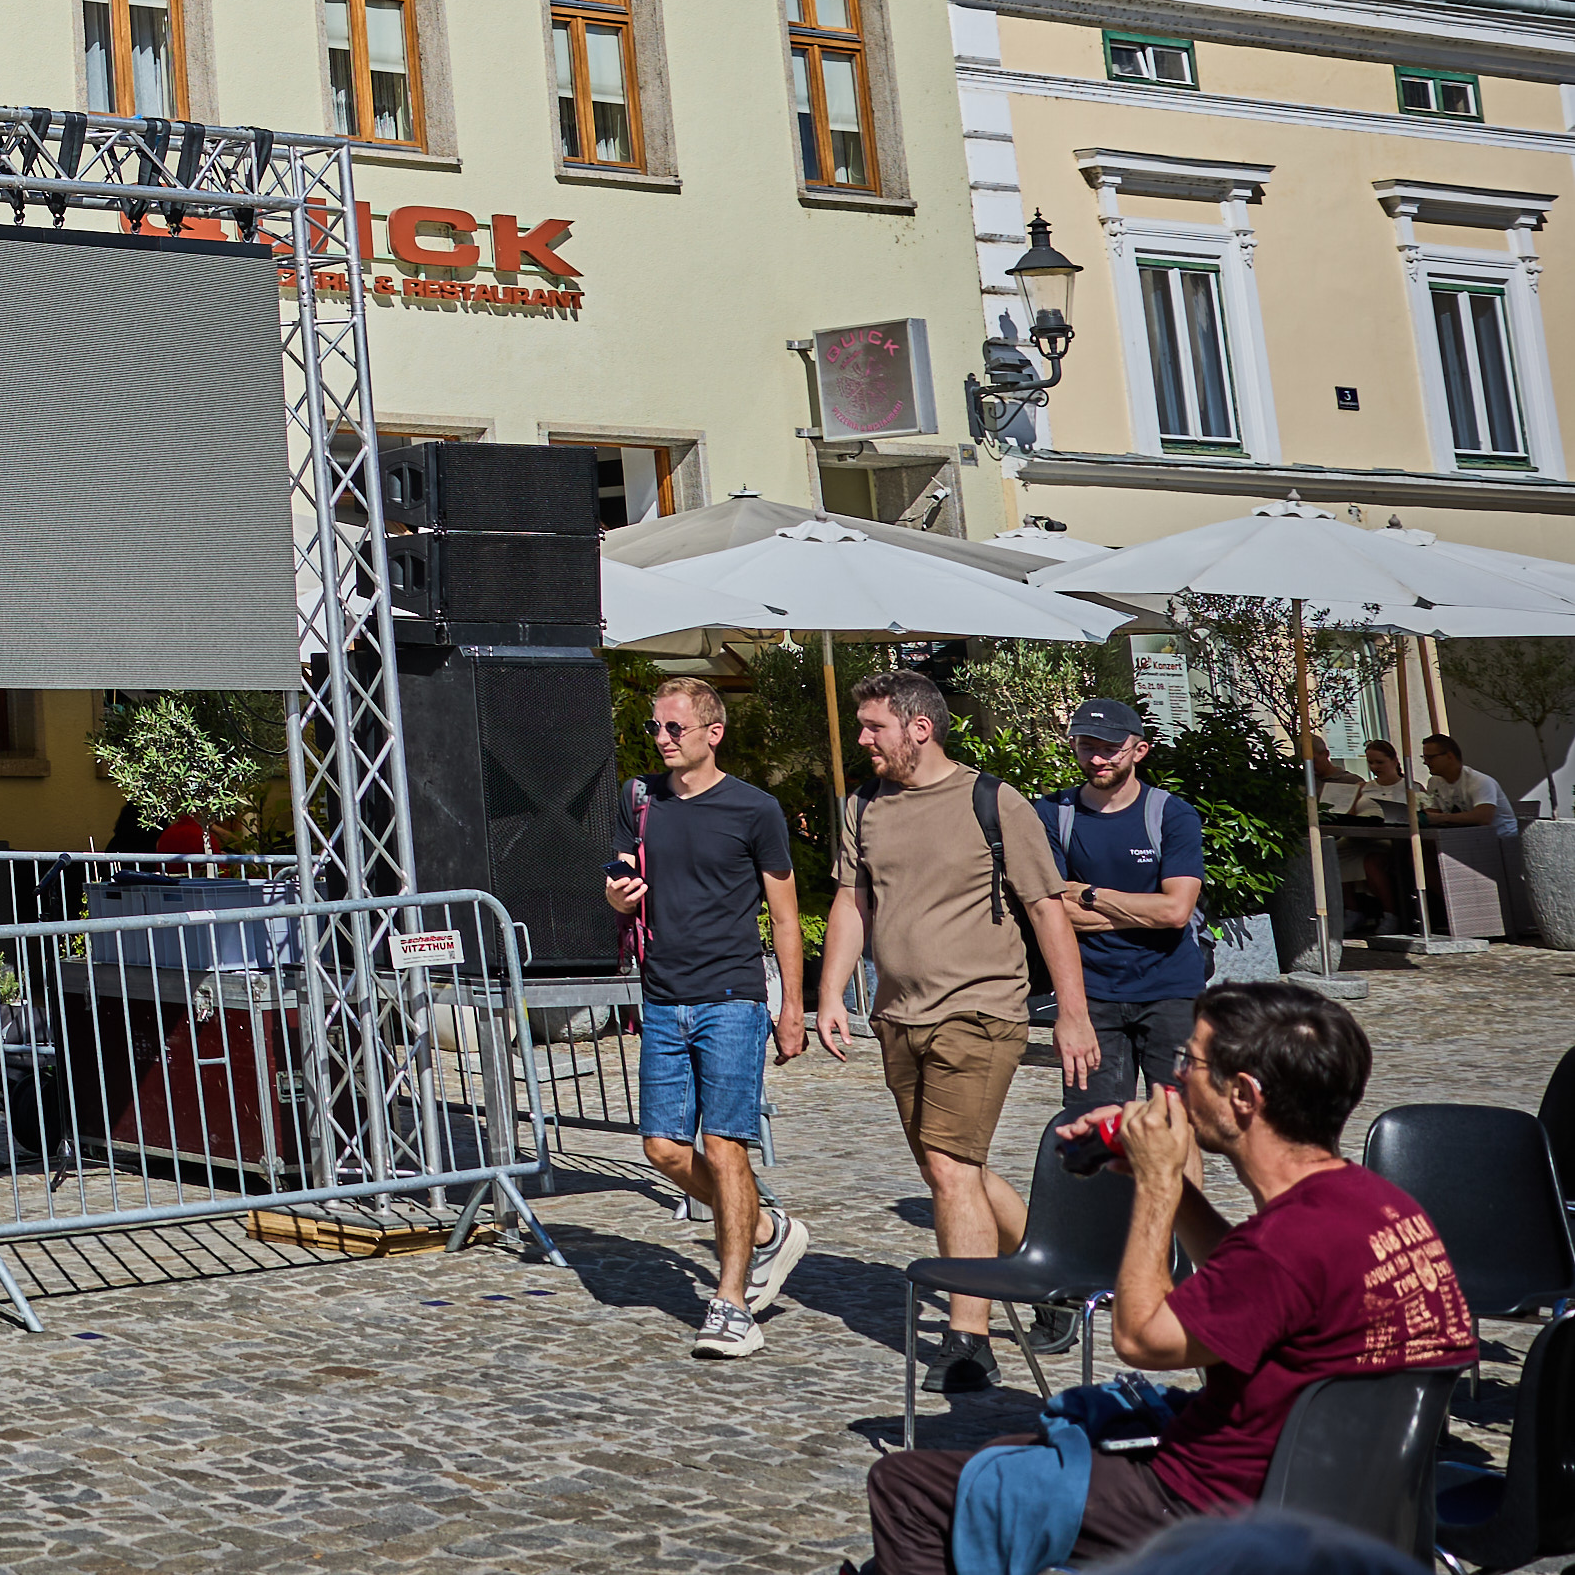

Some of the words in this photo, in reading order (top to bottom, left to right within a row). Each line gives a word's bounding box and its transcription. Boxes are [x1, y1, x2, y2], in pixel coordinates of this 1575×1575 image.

[402, 277, 586, 310] RESTAURANT
[826, 329, 900, 364] QUICK
[1343, 390, 1352, 401] 3
[401, 941, 455, 954] VITZTHUM
[1368, 1226, 1402, 1262] BOB
